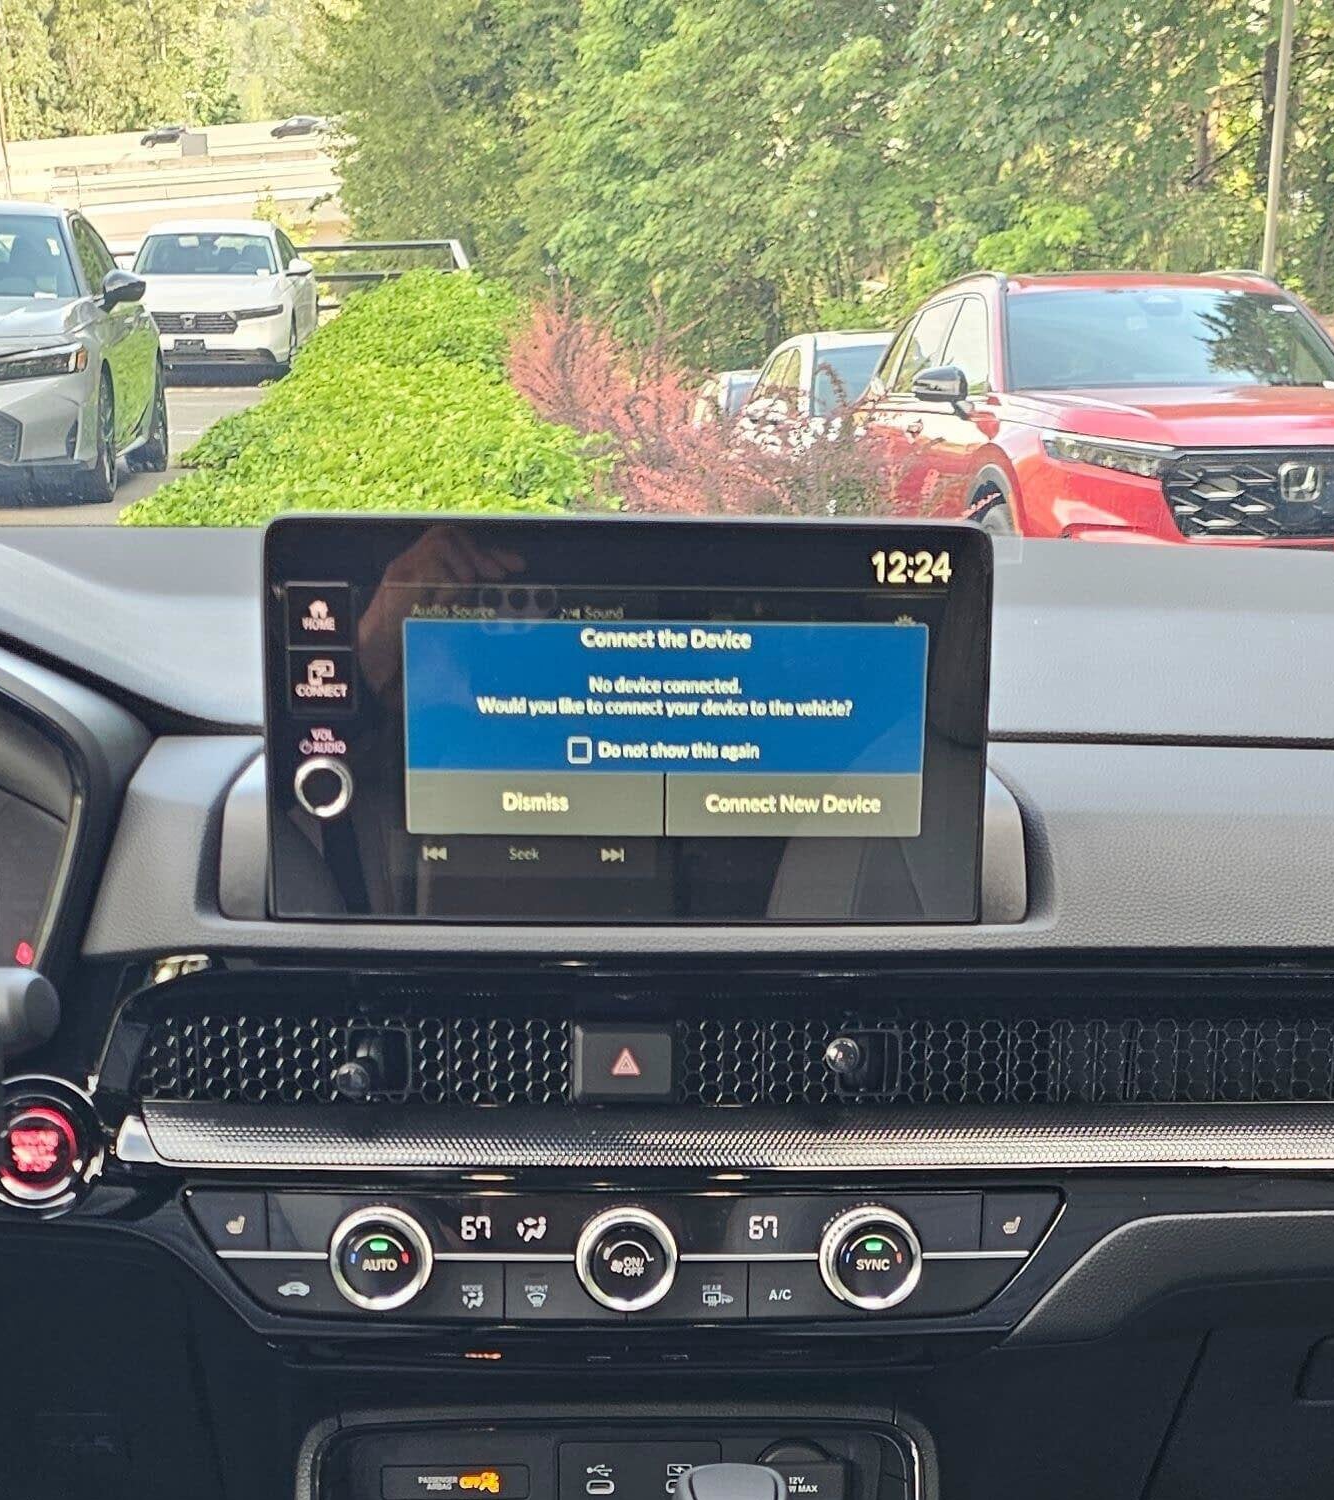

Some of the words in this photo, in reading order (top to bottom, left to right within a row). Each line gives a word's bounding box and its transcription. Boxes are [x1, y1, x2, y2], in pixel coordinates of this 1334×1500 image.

[872, 550, 952, 584] 12:24
[301, 617, 336, 631] HOME
[580, 627, 655, 648] Connect
[658, 629, 687, 648] the
[691, 629, 752, 649] Device
[295, 683, 348, 698] CONNECT
[589, 676, 612, 693] No
[614, 676, 661, 694] device
[663, 676, 742, 695] connected.
[476, 696, 527, 715] Would
[529, 699, 557, 717] you
[559, 697, 585, 715] like
[587, 699, 604, 715] to
[606, 699, 663, 716] connect
[666, 701, 700, 718] your
[701, 700, 749, 717] device
[751, 701, 767, 717] to
[769, 700, 794, 717] the
[796, 700, 853, 718] vehicle?
[310, 727, 335, 742] VOL
[598, 741, 621, 758] Do
[623, 741, 649, 759] not
[651, 742, 689, 759] show
[691, 742, 718, 759] this
[720, 742, 760, 762] again
[501, 791, 570, 813] Dismiss
[704, 793, 777, 815] Connect
[780, 794, 819, 815] New
[822, 794, 882, 816] Device
[508, 846, 540, 862] Seek
[461, 1215, 491, 1241] 67
[748, 1215, 778, 1240] 67
[362, 1258, 398, 1272] AUTO
[624, 1256, 645, 1268] ON/
[855, 1258, 891, 1272] SYNC
[623, 1267, 645, 1277] OFF
[524, 1284, 549, 1292] FRONT
[768, 1288, 793, 1301] A/C
[788, 1476, 805, 1484] 12V
[797, 1484, 818, 1493] MAX
